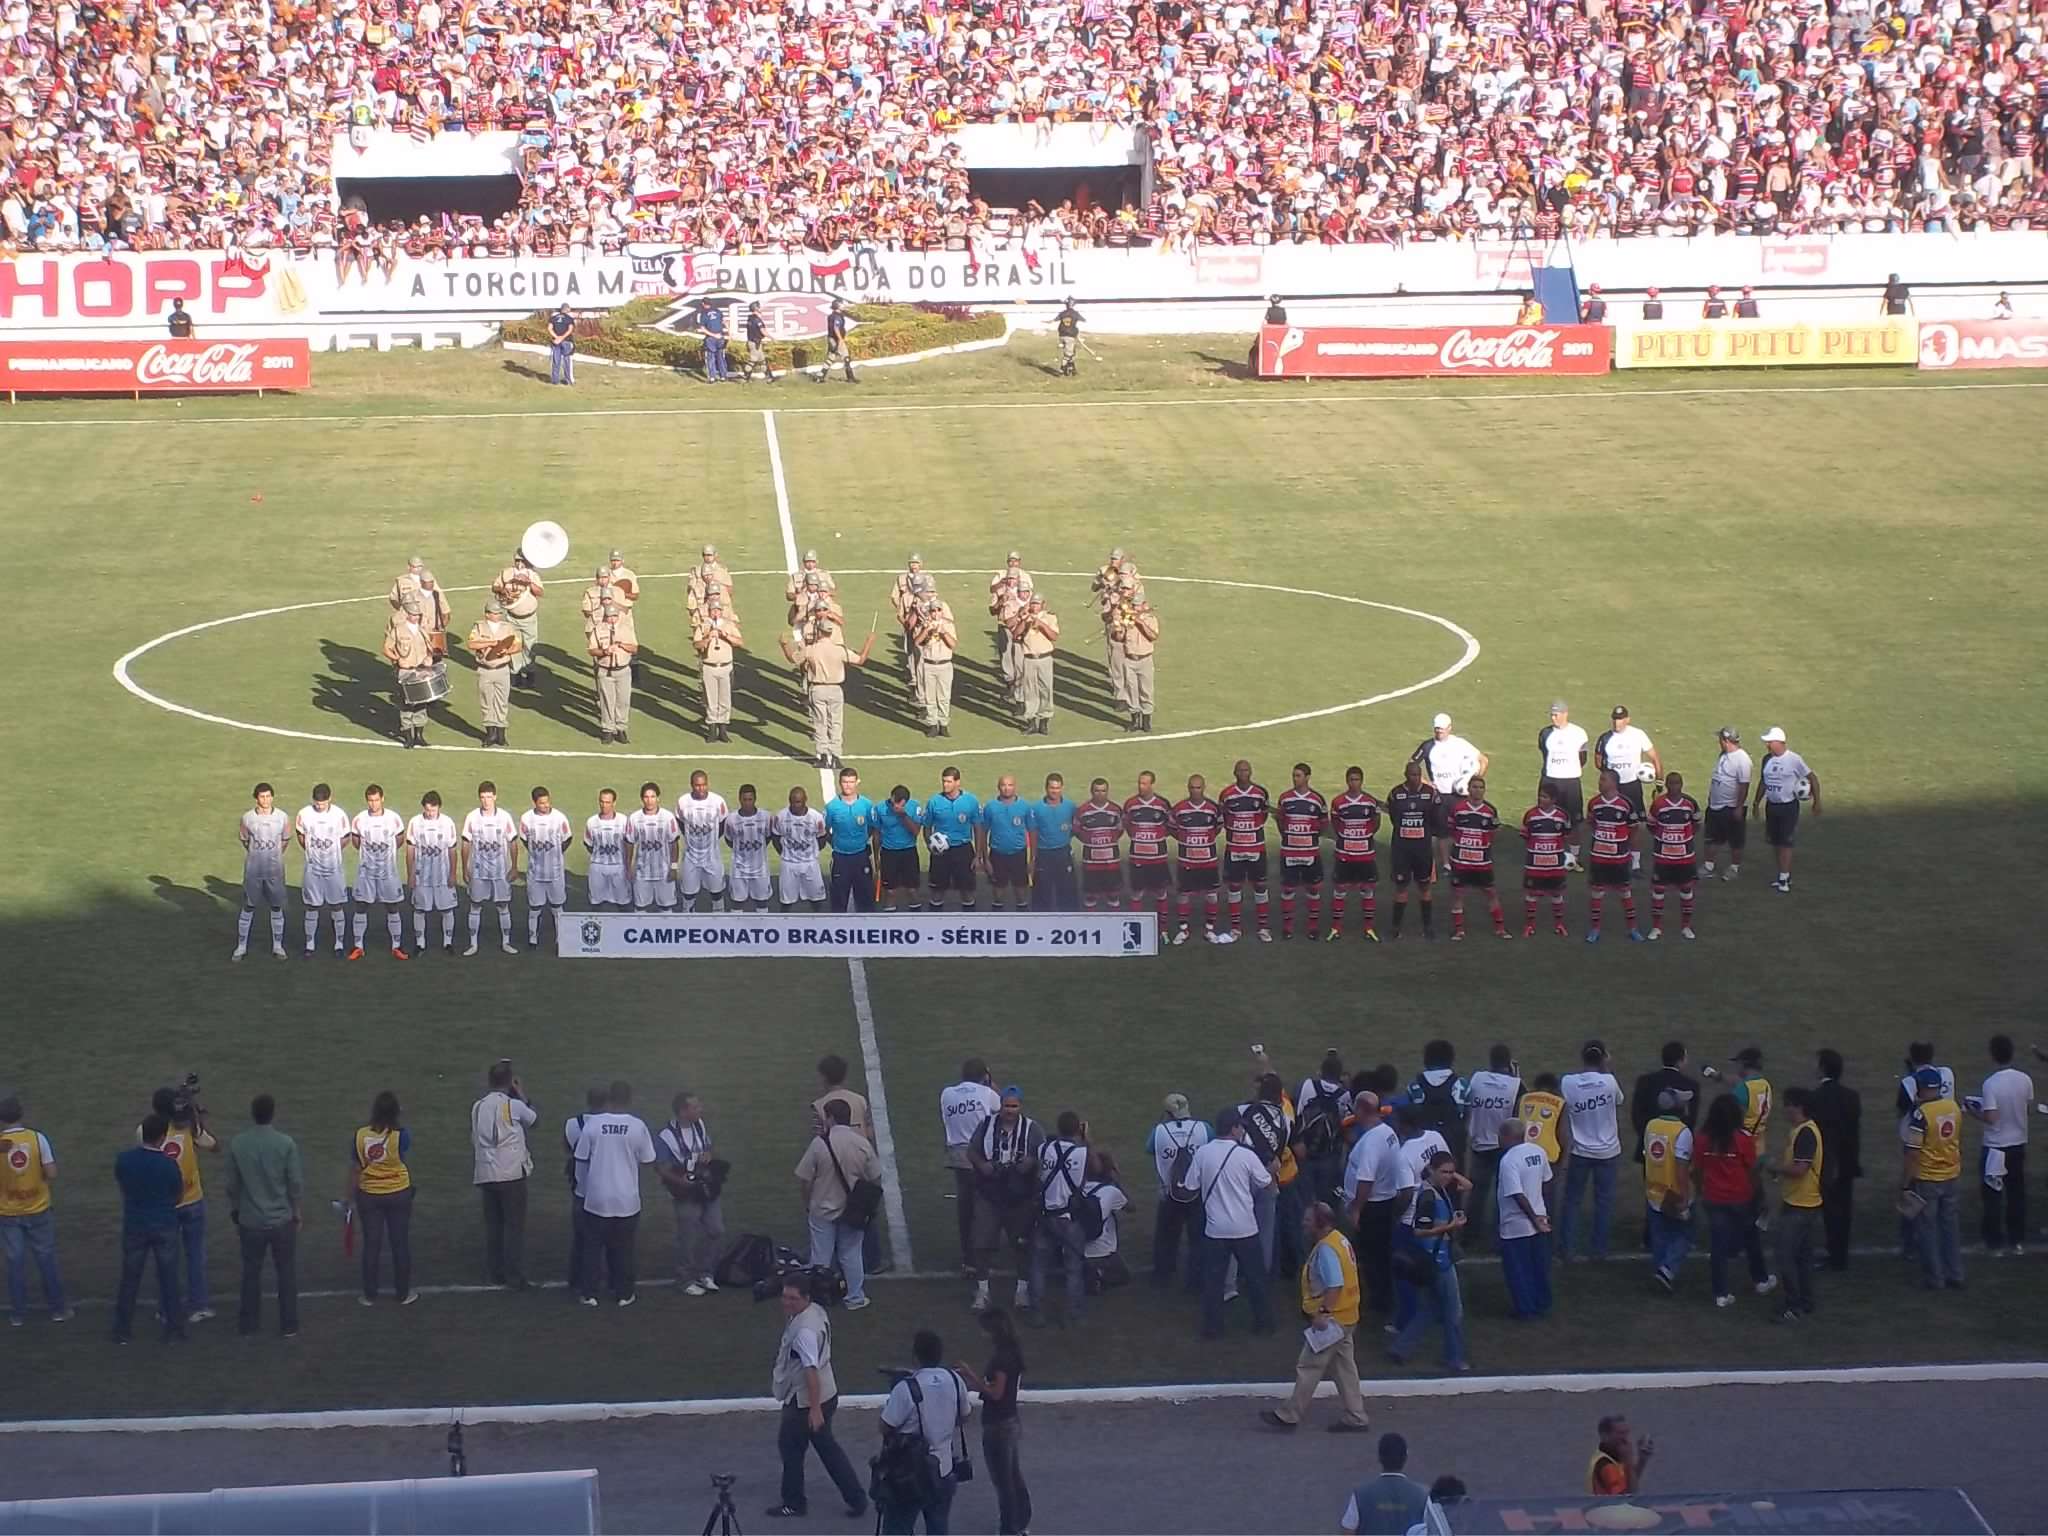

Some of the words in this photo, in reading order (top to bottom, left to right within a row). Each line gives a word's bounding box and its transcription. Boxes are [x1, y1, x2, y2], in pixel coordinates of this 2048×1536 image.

[411, 272, 426, 298] A
[444, 270, 581, 298] TORCIDA
[908, 264, 946, 290] DO
[963, 261, 1076, 288] BRASIL
[1440, 329, 1561, 368] Coca-Cola
[136, 343, 260, 384] Coca-Cola
[262, 355, 294, 369] 2011
[1287, 823, 1312, 832] POTY
[1401, 818, 1425, 827] POTY
[623, 928, 780, 944] CAMPEONATO
[787, 928, 920, 945] BRASILEIRO
[941, 926, 1007, 945] SÉRIE
[1015, 929, 1030, 945] D
[1050, 929, 1102, 945] 2011
[601, 1124, 629, 1135] STAFF
